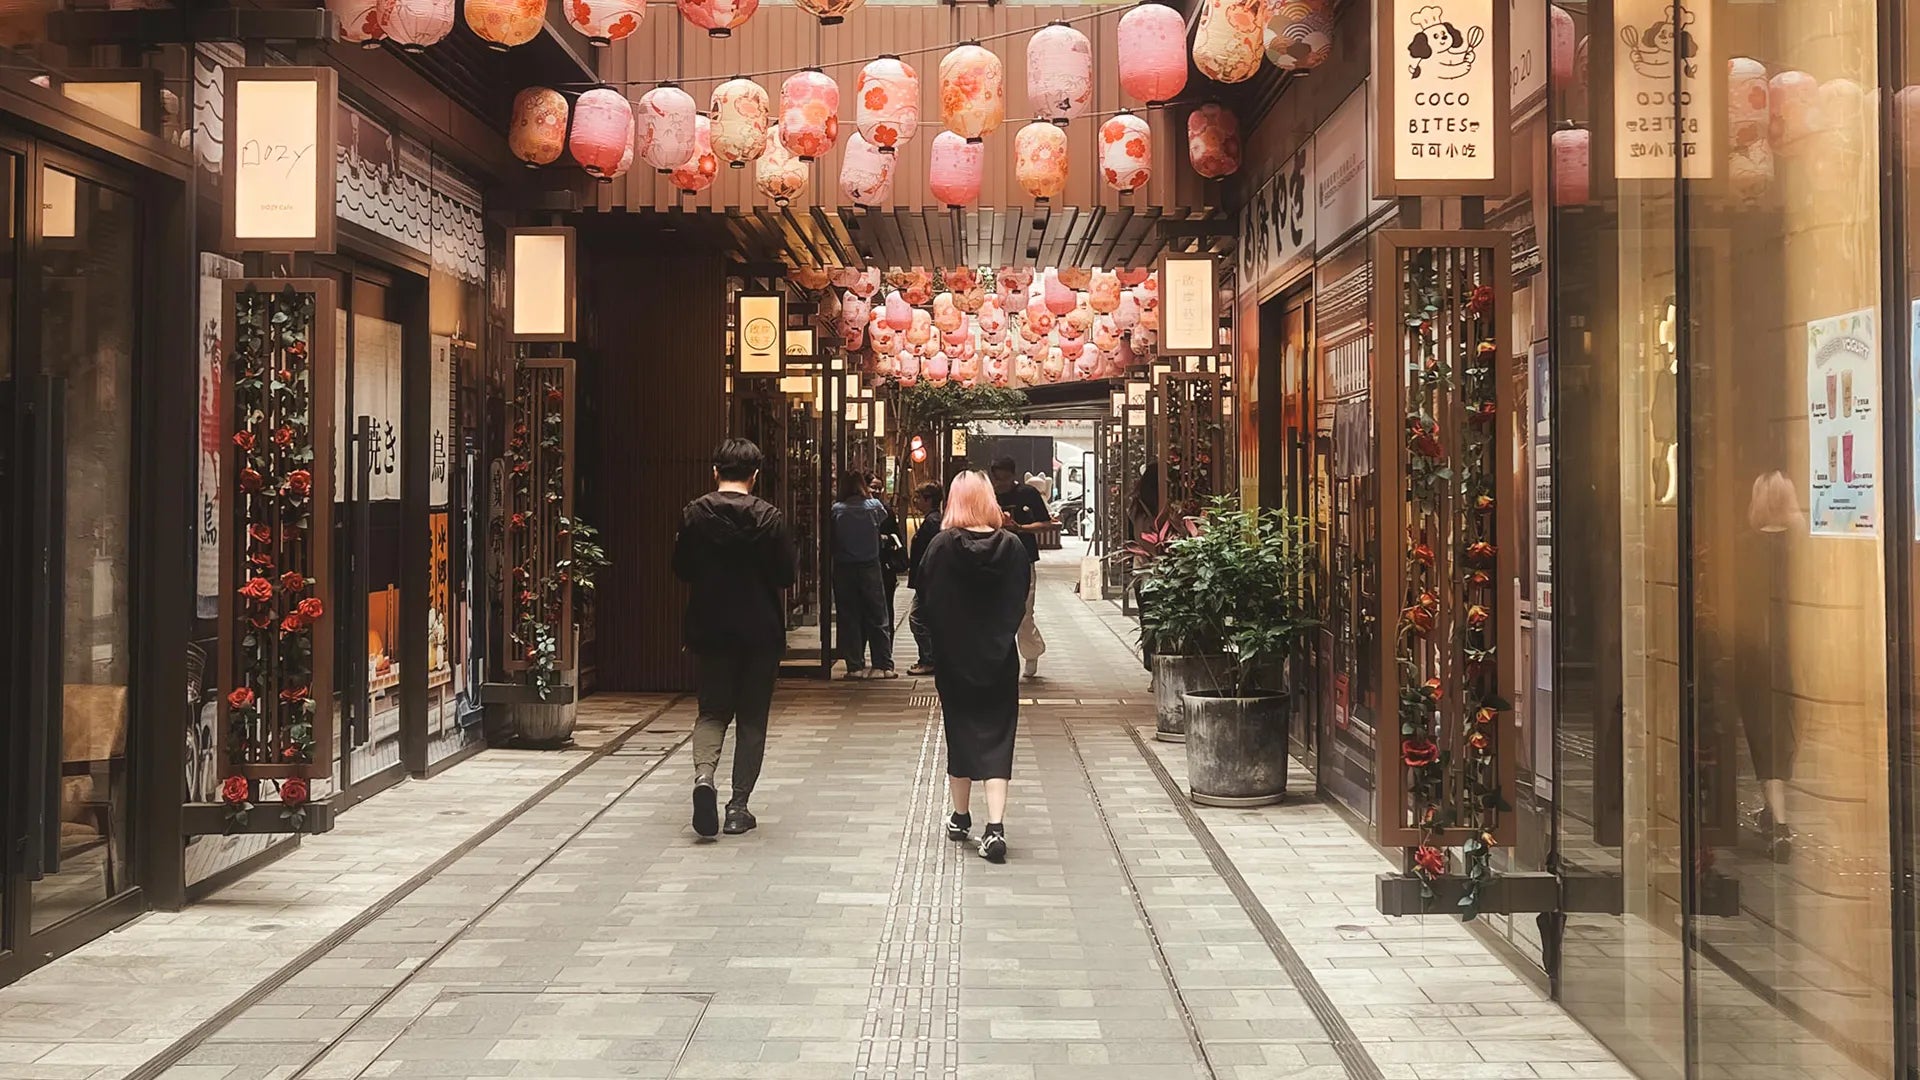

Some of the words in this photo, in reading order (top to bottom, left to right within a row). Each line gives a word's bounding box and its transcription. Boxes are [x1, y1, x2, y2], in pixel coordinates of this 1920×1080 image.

[1415, 92, 1470, 106] COCO
[1408, 118, 1468, 134] BITES
[1411, 143, 1477, 158] 可可小吃
[1842, 337, 1869, 360] YOGURT
